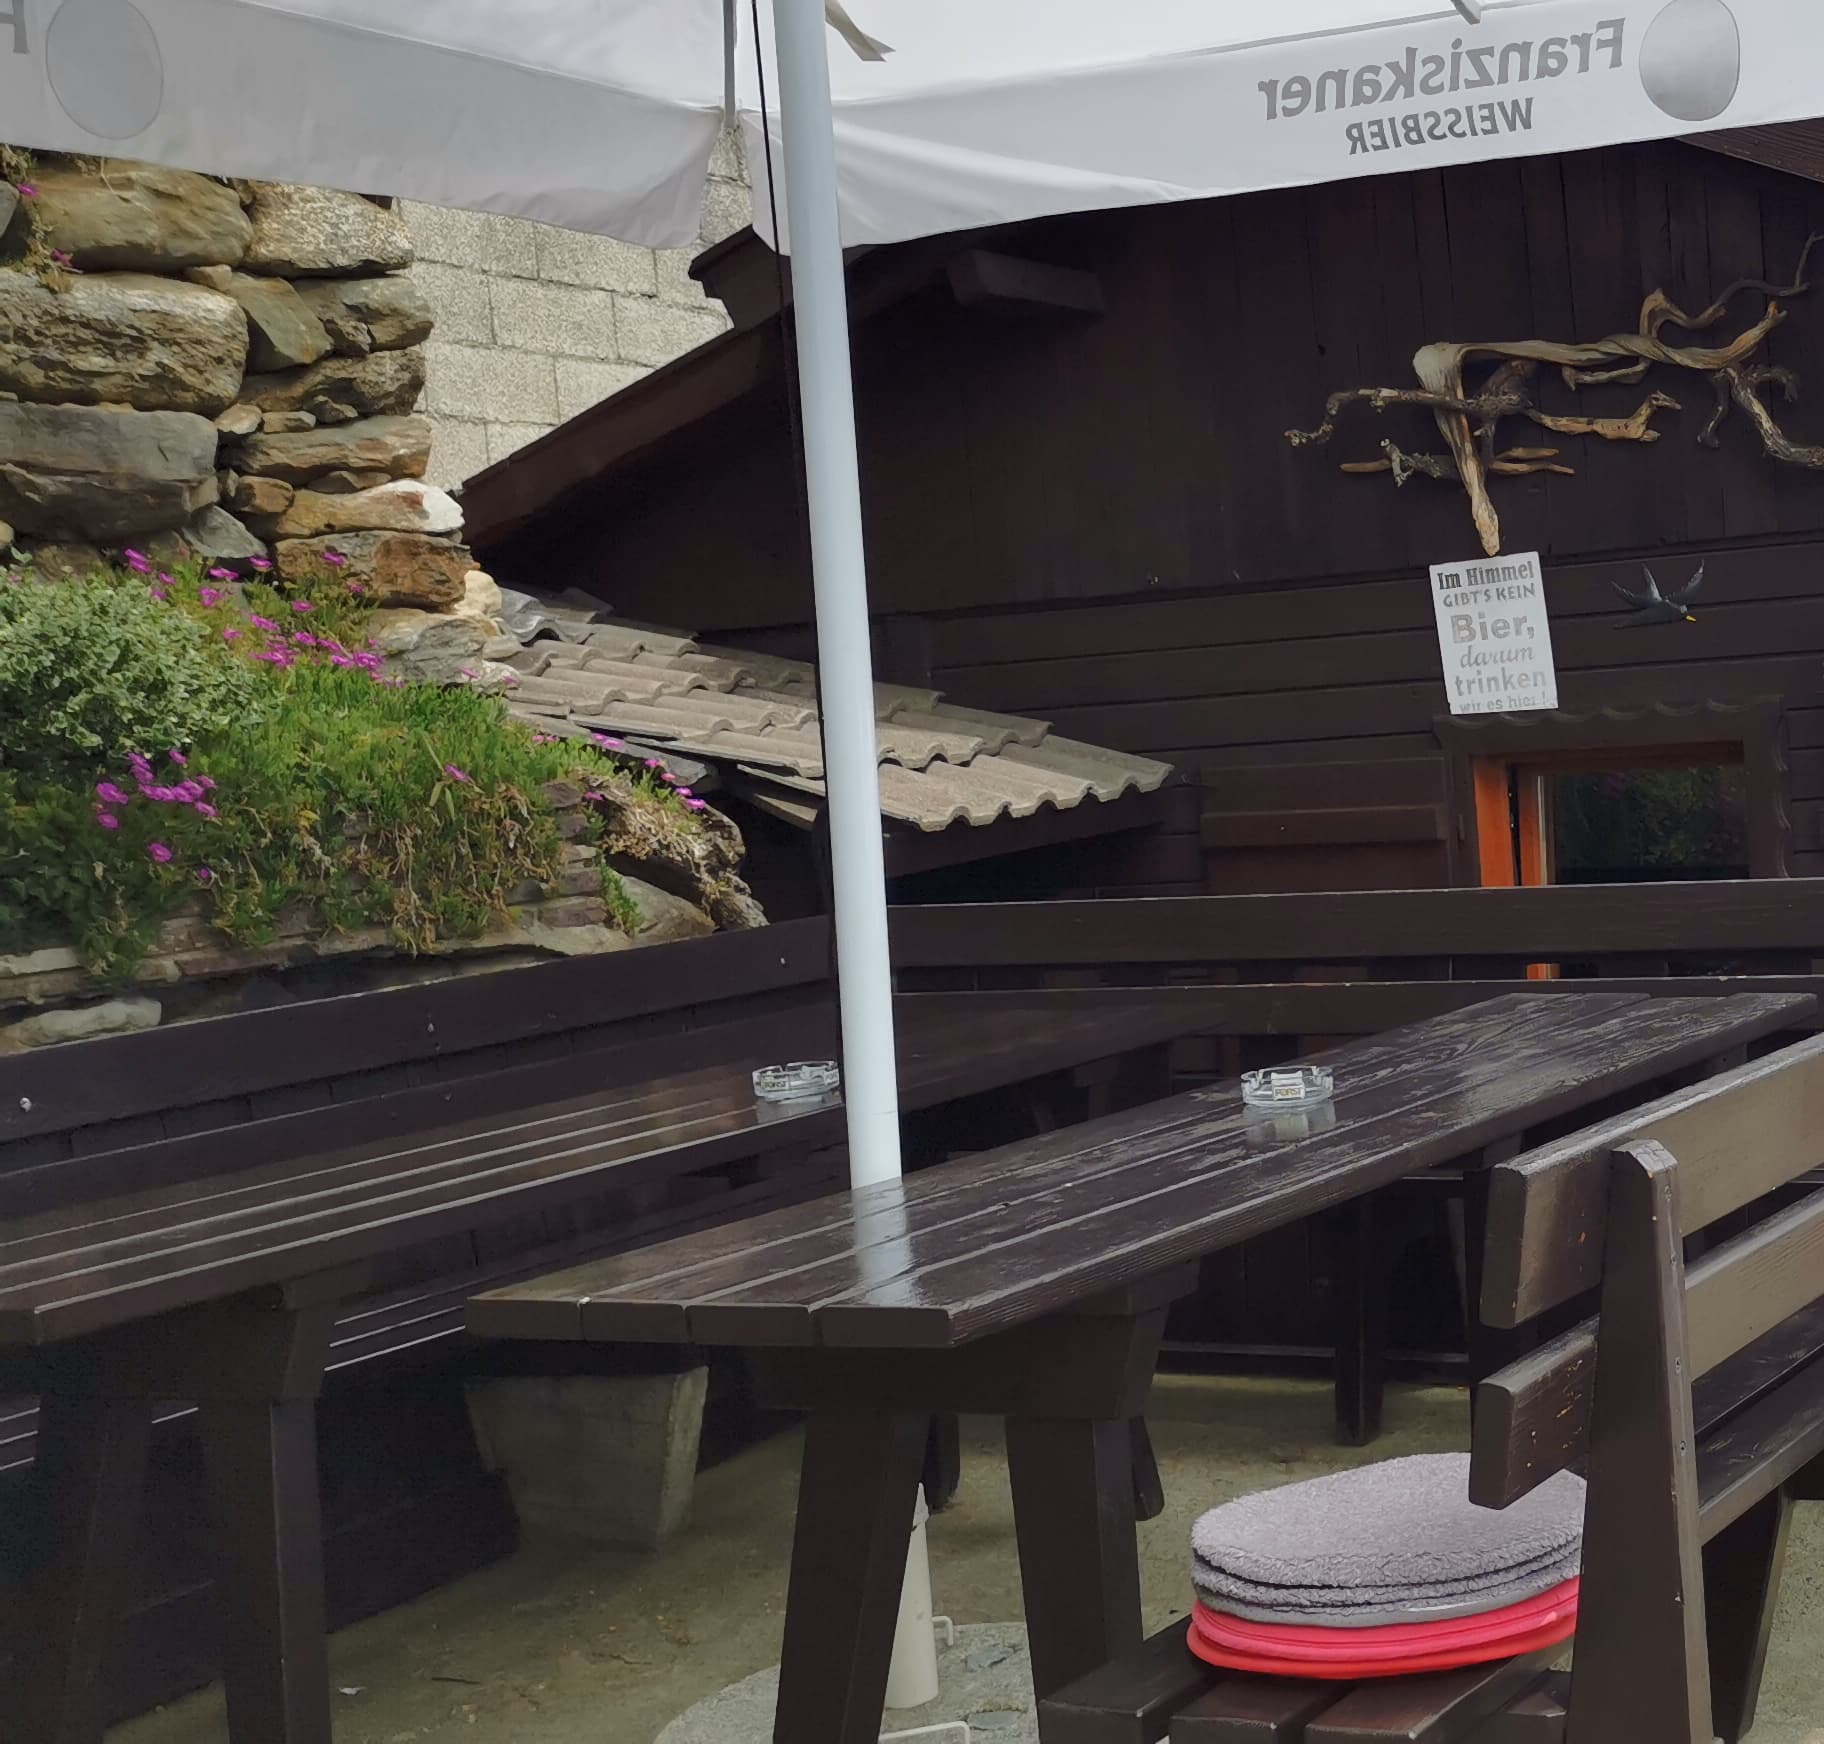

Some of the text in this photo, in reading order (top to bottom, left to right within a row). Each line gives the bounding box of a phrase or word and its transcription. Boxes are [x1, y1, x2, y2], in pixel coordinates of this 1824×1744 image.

[1437, 560, 1534, 590] Im Himmel
[1443, 583, 1535, 607] GIBT'S KEIN
[1450, 611, 1535, 644] Bier,
[1460, 645, 1535, 668] darum
[1455, 666, 1547, 696] trinken
[1459, 701, 1481, 713] wir
[1487, 699, 1503, 710] es
